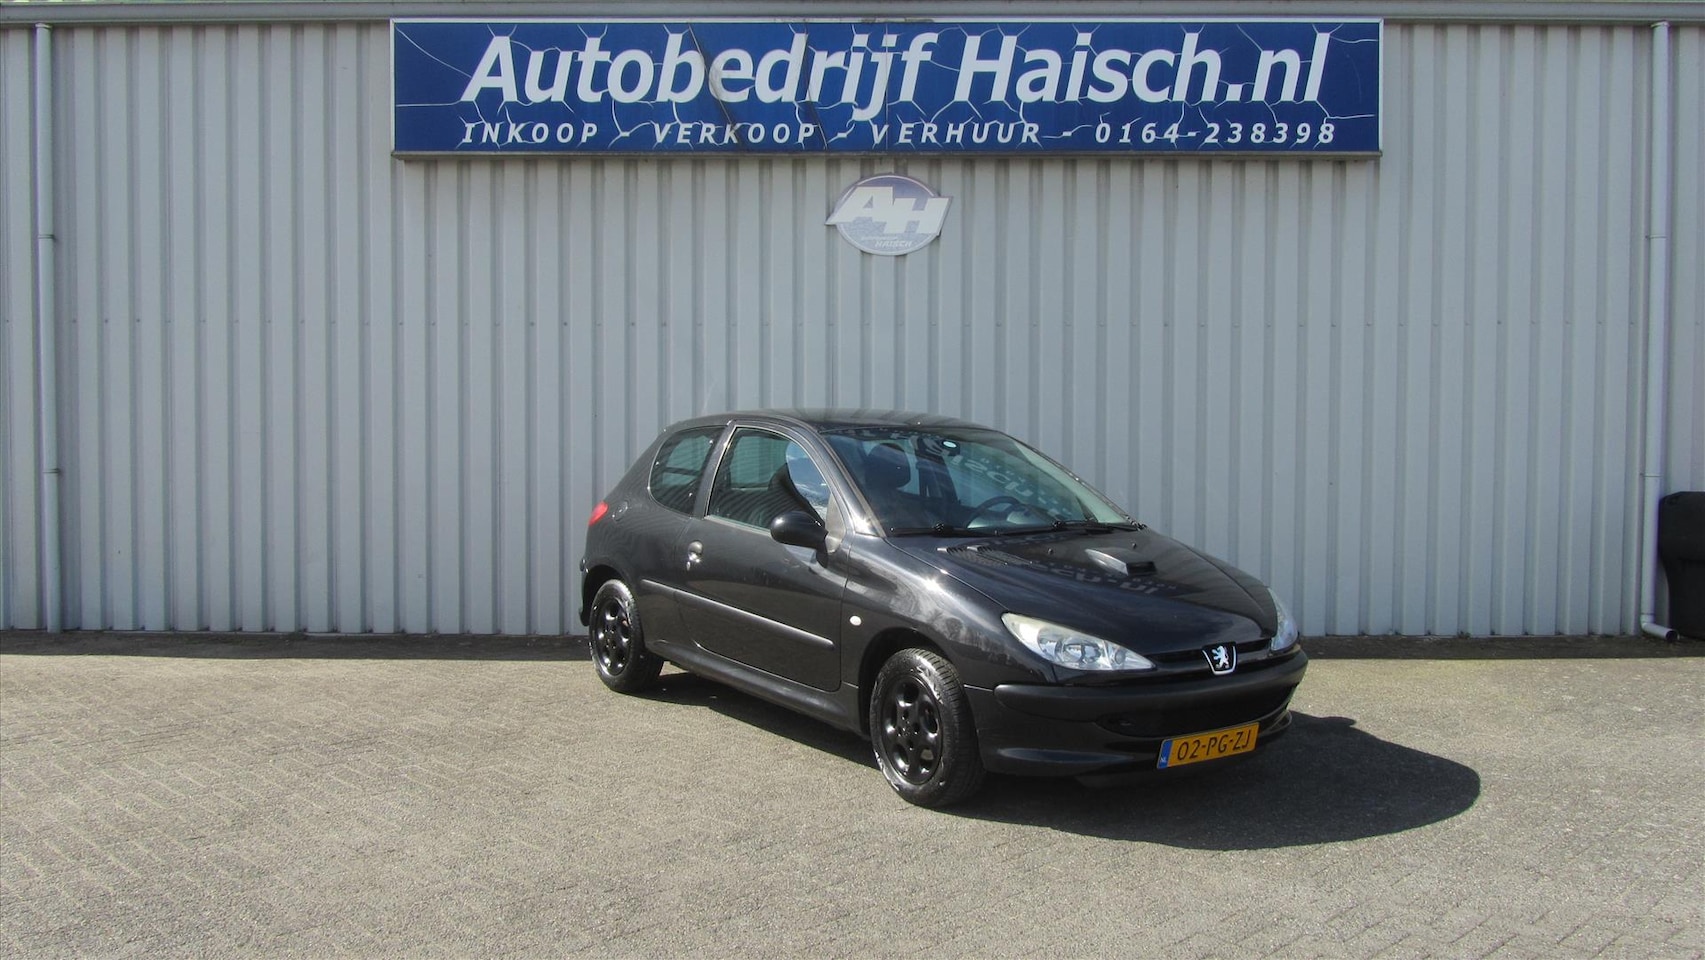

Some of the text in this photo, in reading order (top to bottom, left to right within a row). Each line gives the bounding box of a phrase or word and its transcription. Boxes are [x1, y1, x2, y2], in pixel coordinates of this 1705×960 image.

[460, 32, 1330, 121] Autobedrijf Haisch.nl
[462, 123, 599, 144] INKOOP
[654, 123, 816, 144] VERKOOP
[872, 123, 1040, 144] VERHUUR
[1095, 123, 1335, 144] 0164-238398
[824, 186, 949, 235] AH
[1177, 729, 1251, 761] 02-PG-ZJ
